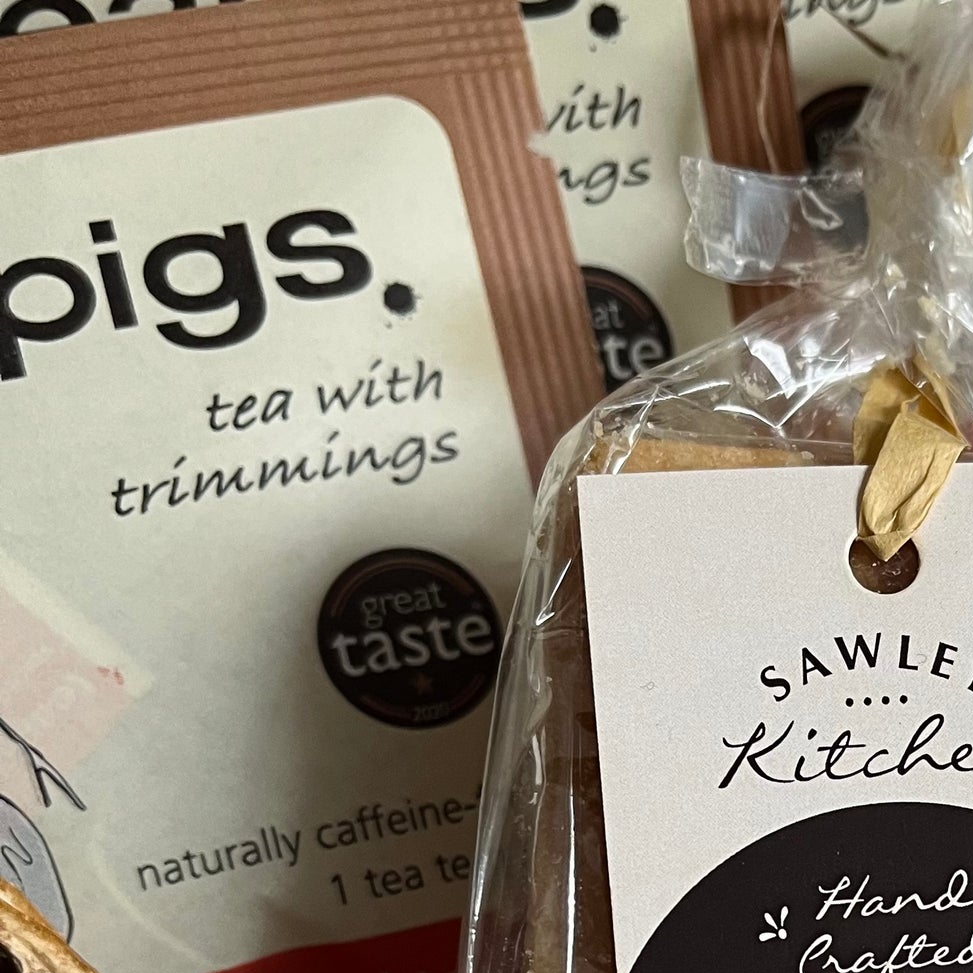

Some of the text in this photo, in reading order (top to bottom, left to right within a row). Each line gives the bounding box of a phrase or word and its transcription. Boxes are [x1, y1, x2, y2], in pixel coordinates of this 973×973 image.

[206, 358, 444, 432] tea with
[110, 428, 459, 517] trimmings
[361, 582, 447, 628] great
[332, 615, 495, 677] taste
[137, 785, 484, 893] naturally caffeine-
[331, 873, 348, 905] 1
[364, 865, 425, 899] tea
